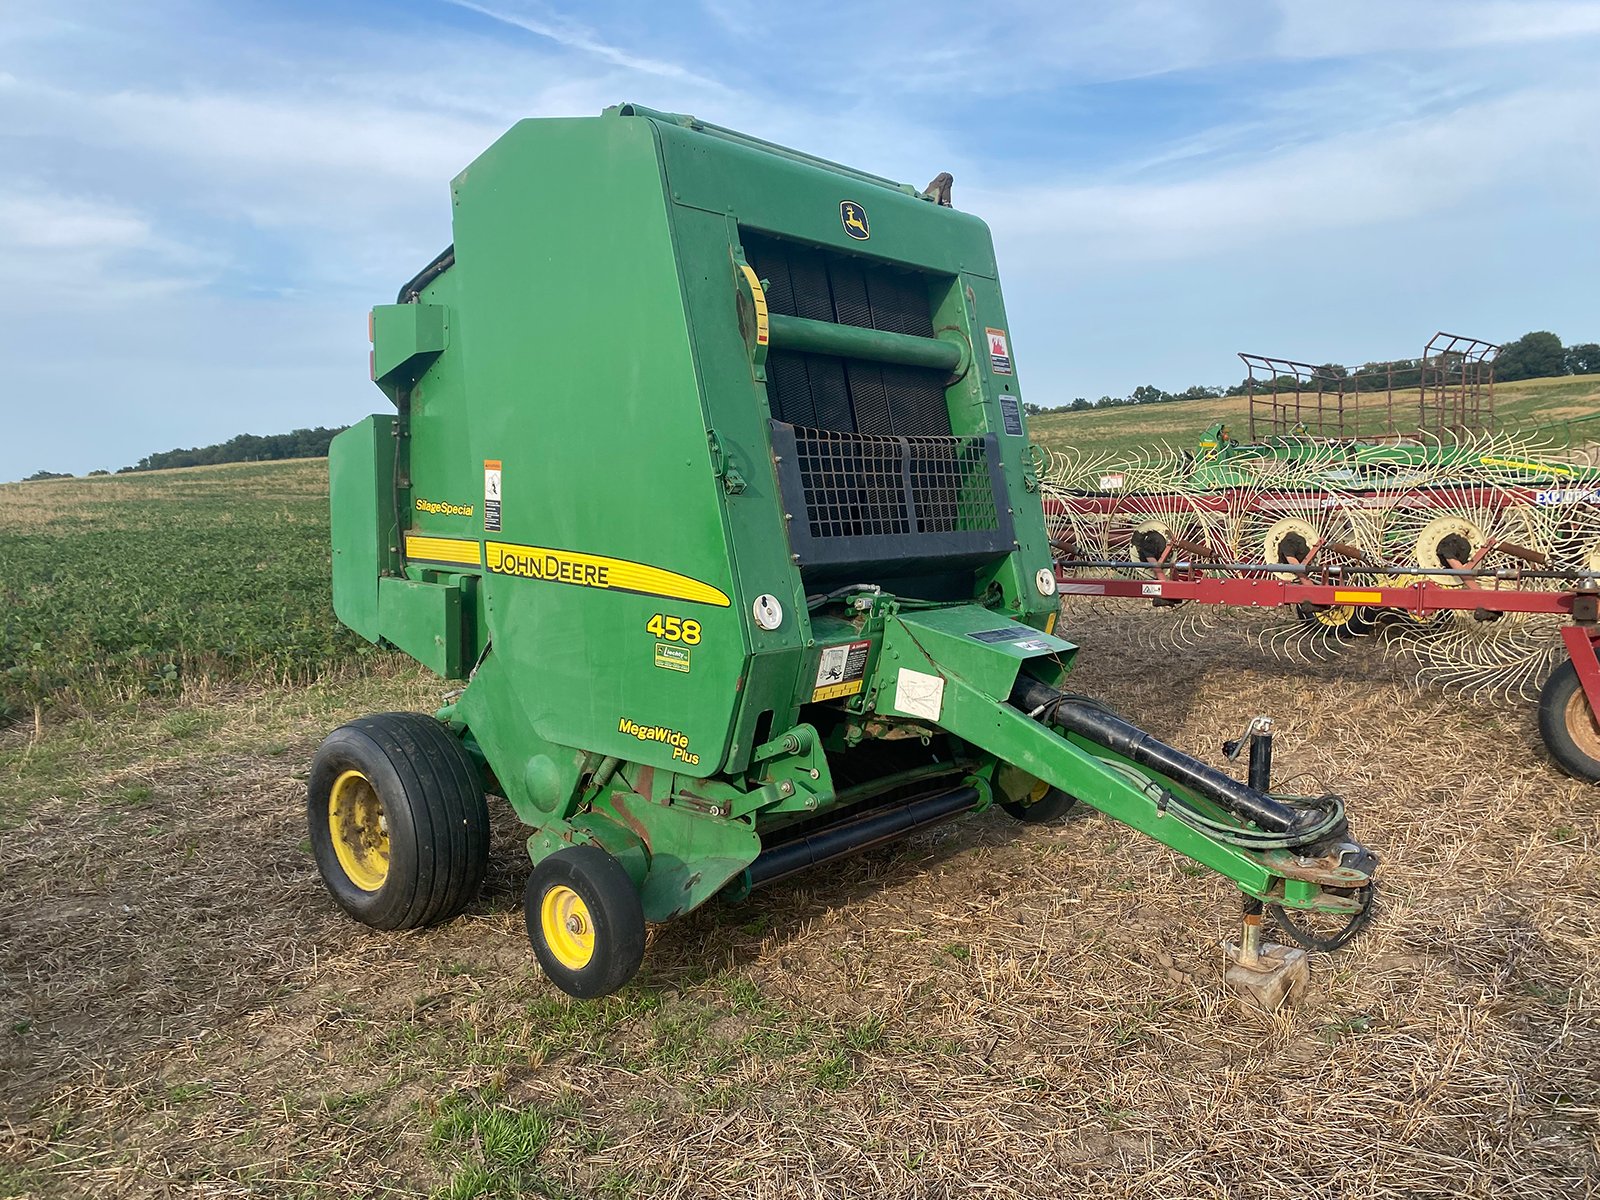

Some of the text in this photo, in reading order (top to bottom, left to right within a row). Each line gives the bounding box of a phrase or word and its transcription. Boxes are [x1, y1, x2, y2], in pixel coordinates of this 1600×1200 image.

[415, 498, 474, 517] SilageSpecial
[494, 549, 609, 585] JOHN DEERE
[646, 613, 702, 646] 458
[618, 717, 689, 748] MegaWide
[672, 746, 700, 765] Plus
